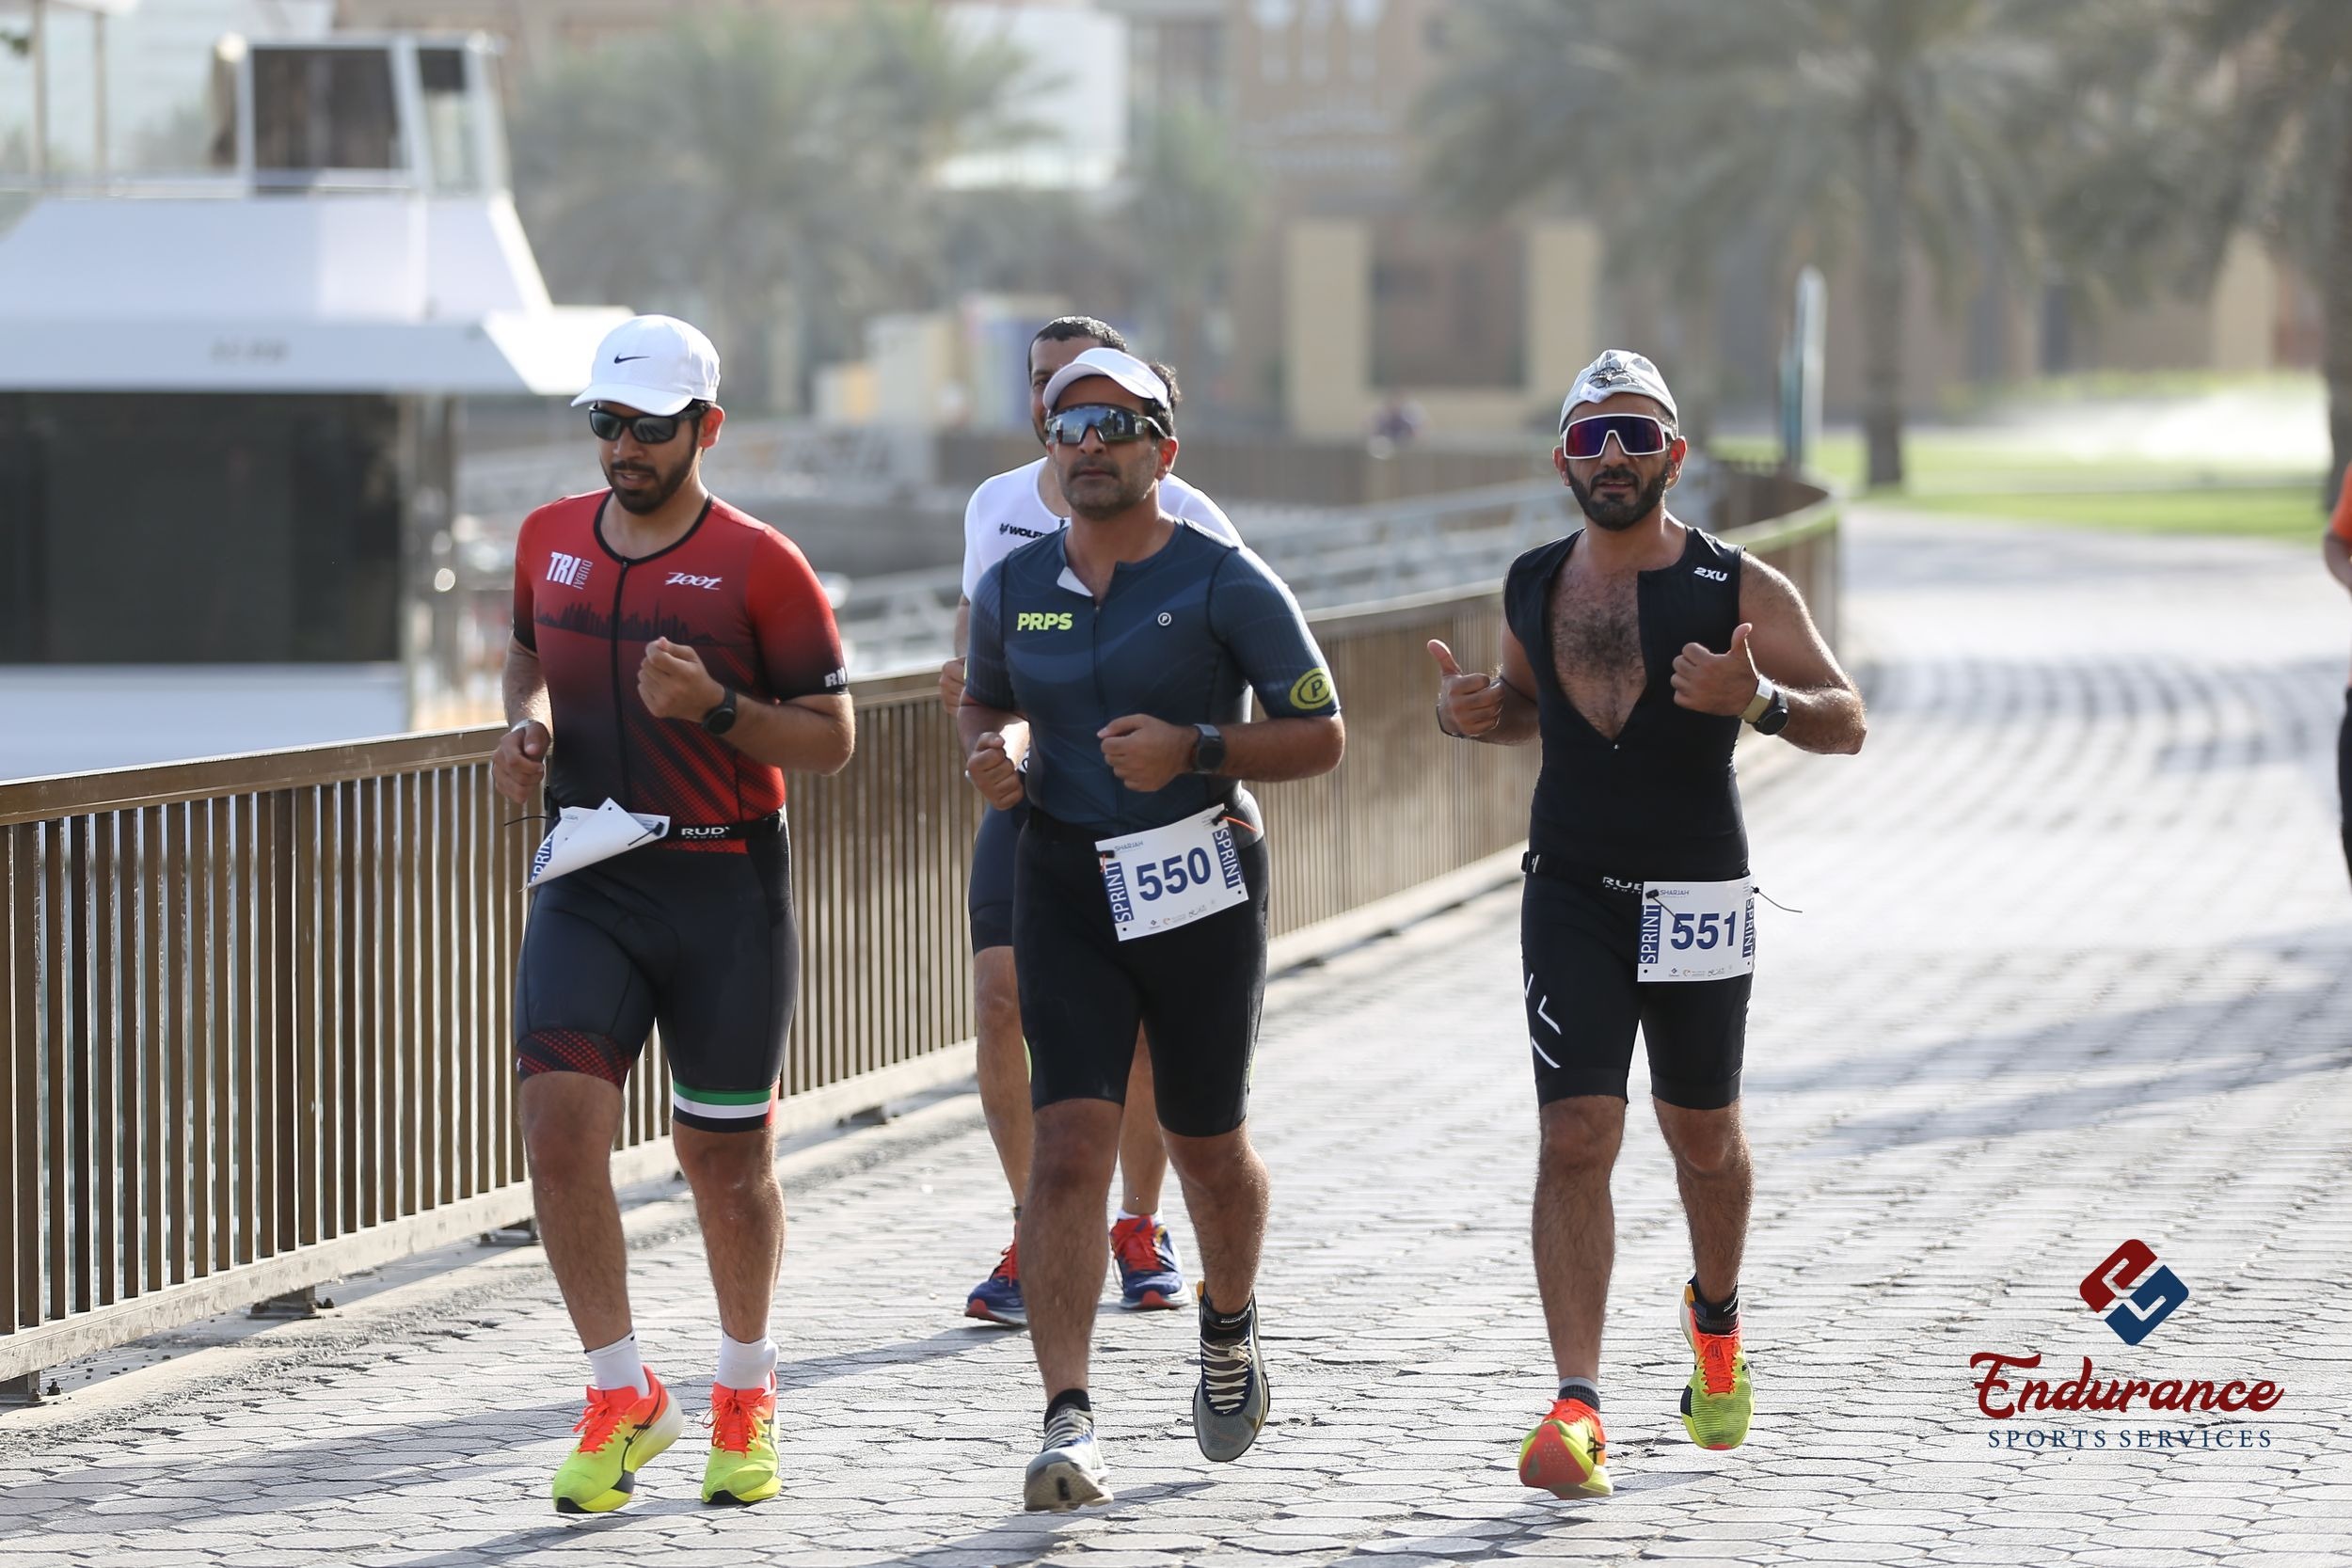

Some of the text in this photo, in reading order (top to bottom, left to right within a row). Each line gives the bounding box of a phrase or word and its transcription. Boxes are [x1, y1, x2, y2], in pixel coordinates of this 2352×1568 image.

[546, 551, 581, 586] TRI
[573, 560, 594, 590] DUBAI
[1693, 566, 1728, 582] 2XU
[1017, 612, 1073, 631] PRPS
[680, 826, 730, 836] RUD
[1136, 847, 1211, 902] 550
[1215, 828, 1243, 890] SPRINT
[1104, 863, 1133, 924] SPRINT
[1640, 904, 1661, 964] SPRINT
[1670, 911, 1737, 951] 551
[1743, 897, 1755, 957] SPRINT
